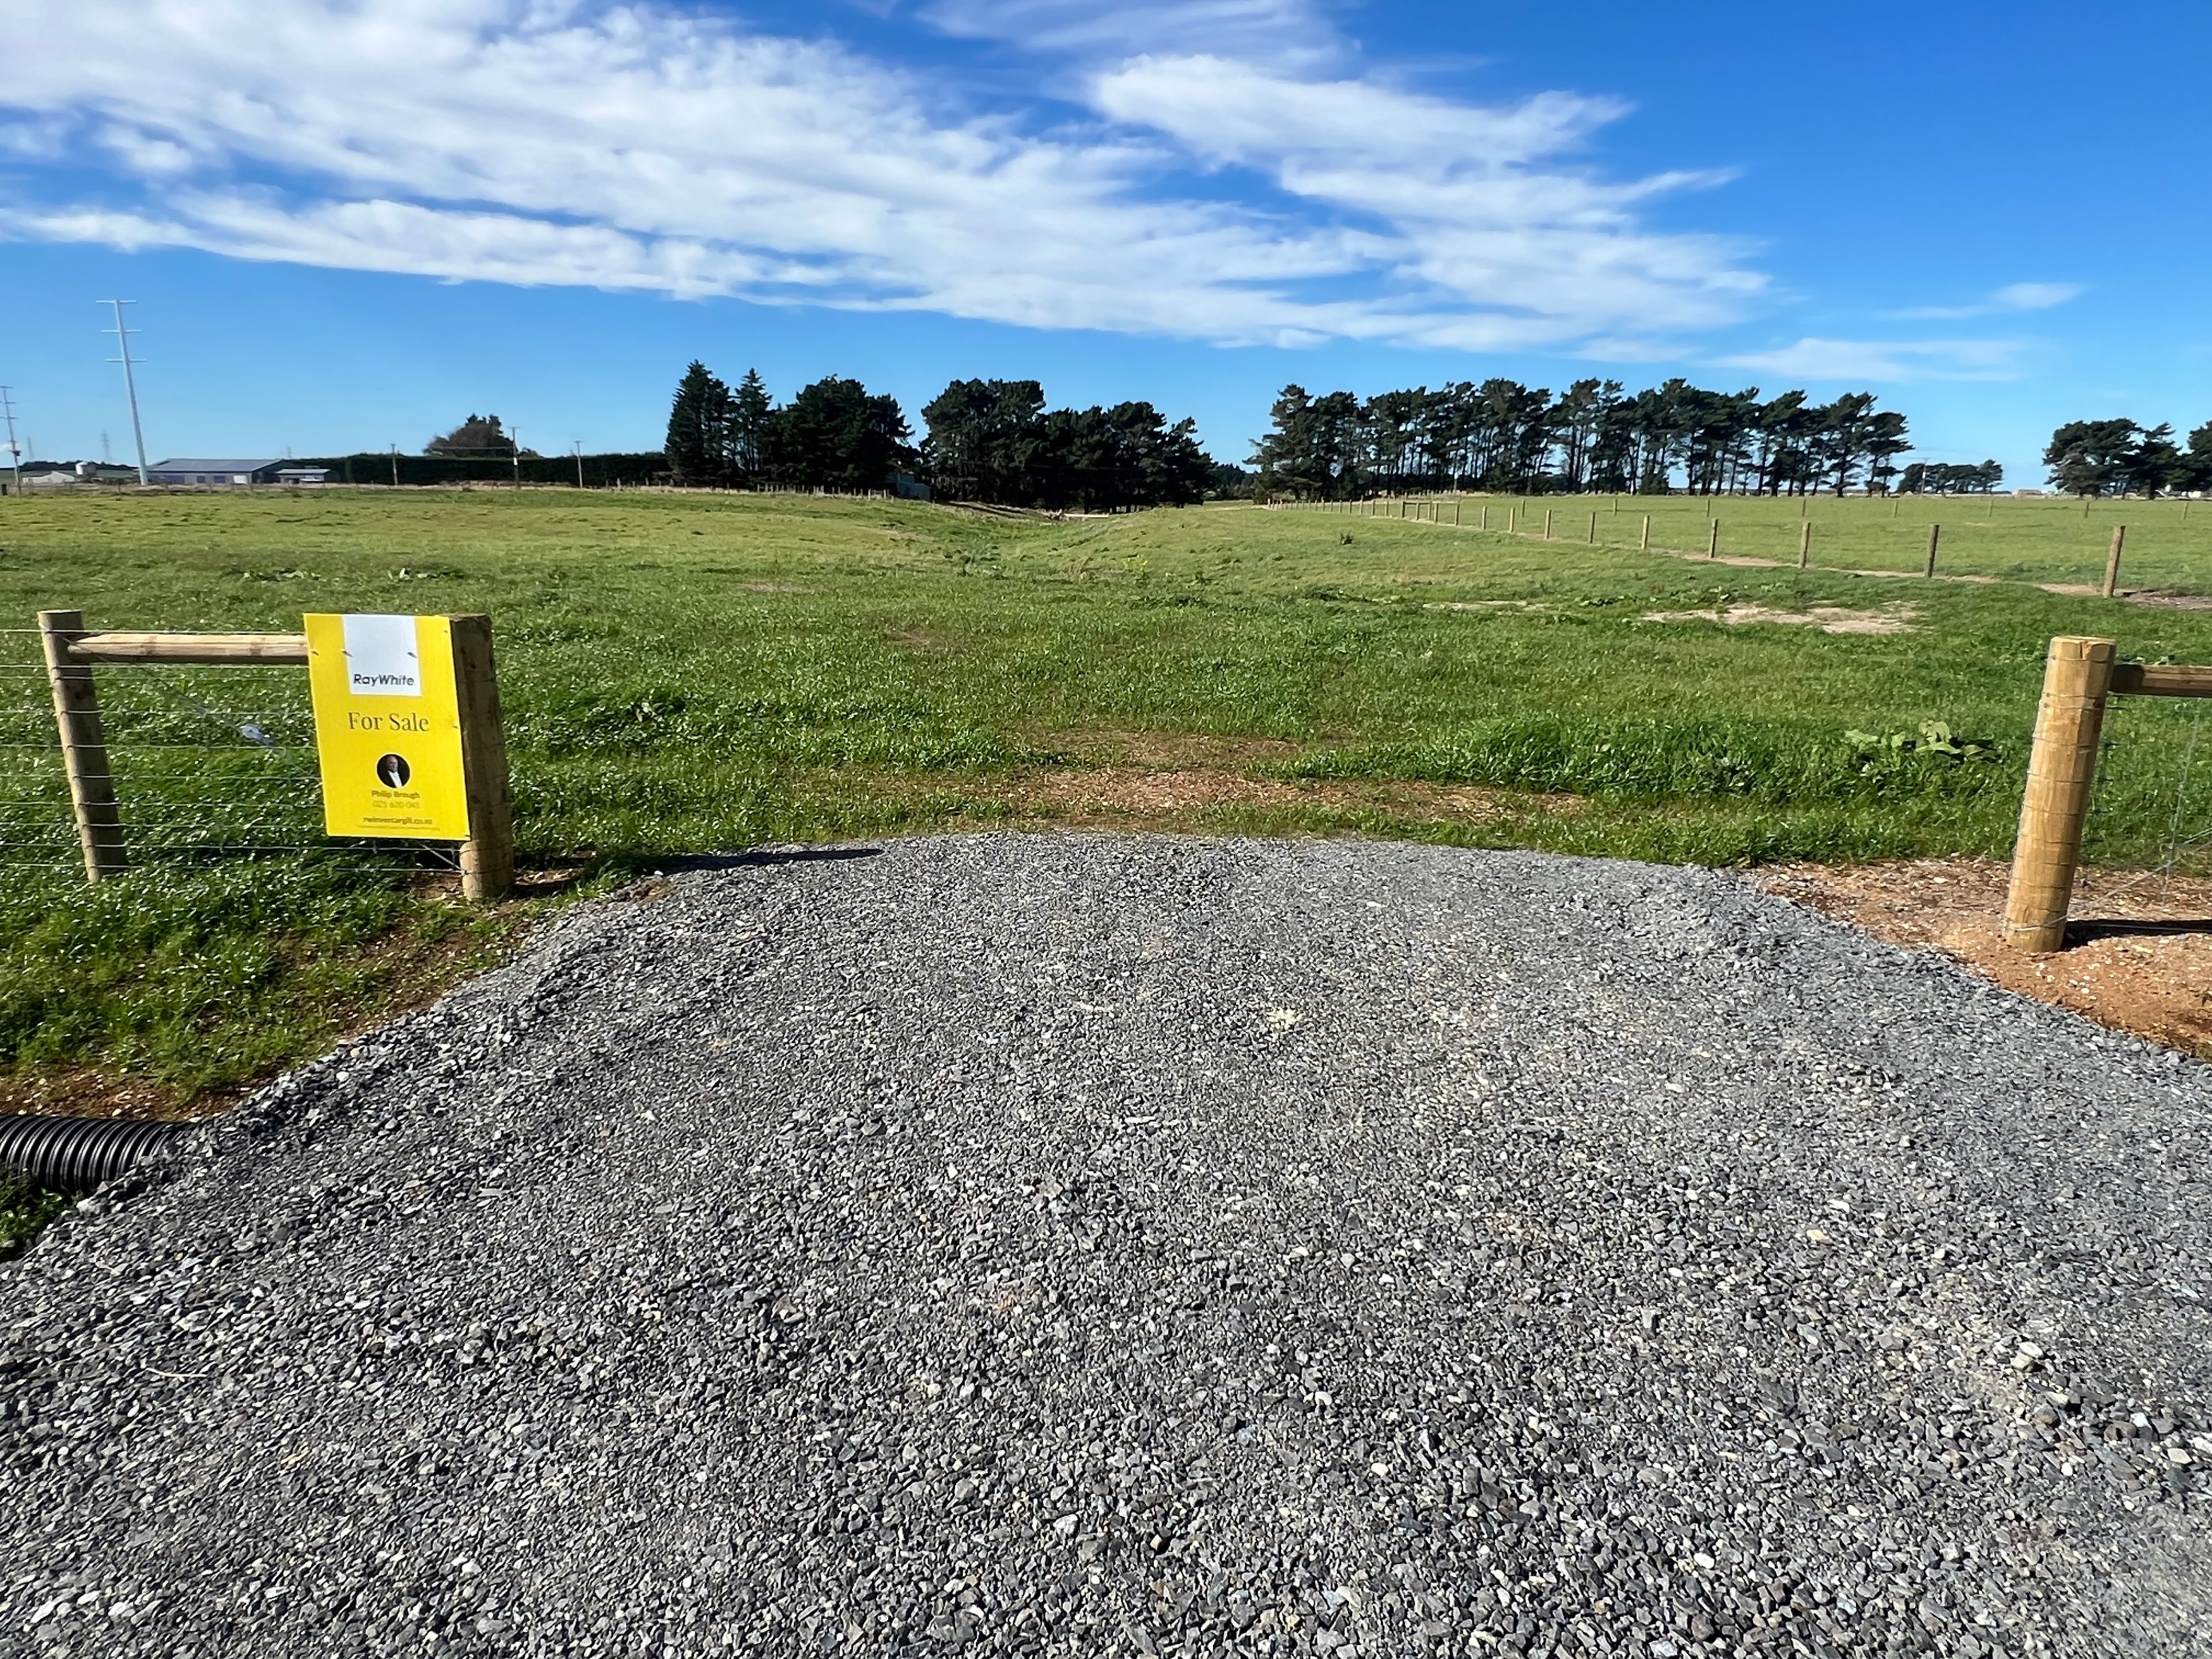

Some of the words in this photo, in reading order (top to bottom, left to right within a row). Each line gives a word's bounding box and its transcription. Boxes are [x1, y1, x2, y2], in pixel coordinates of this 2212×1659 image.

[354, 674, 414, 687] RayWhite
[348, 712, 383, 730] For
[389, 713, 429, 732] Sale
